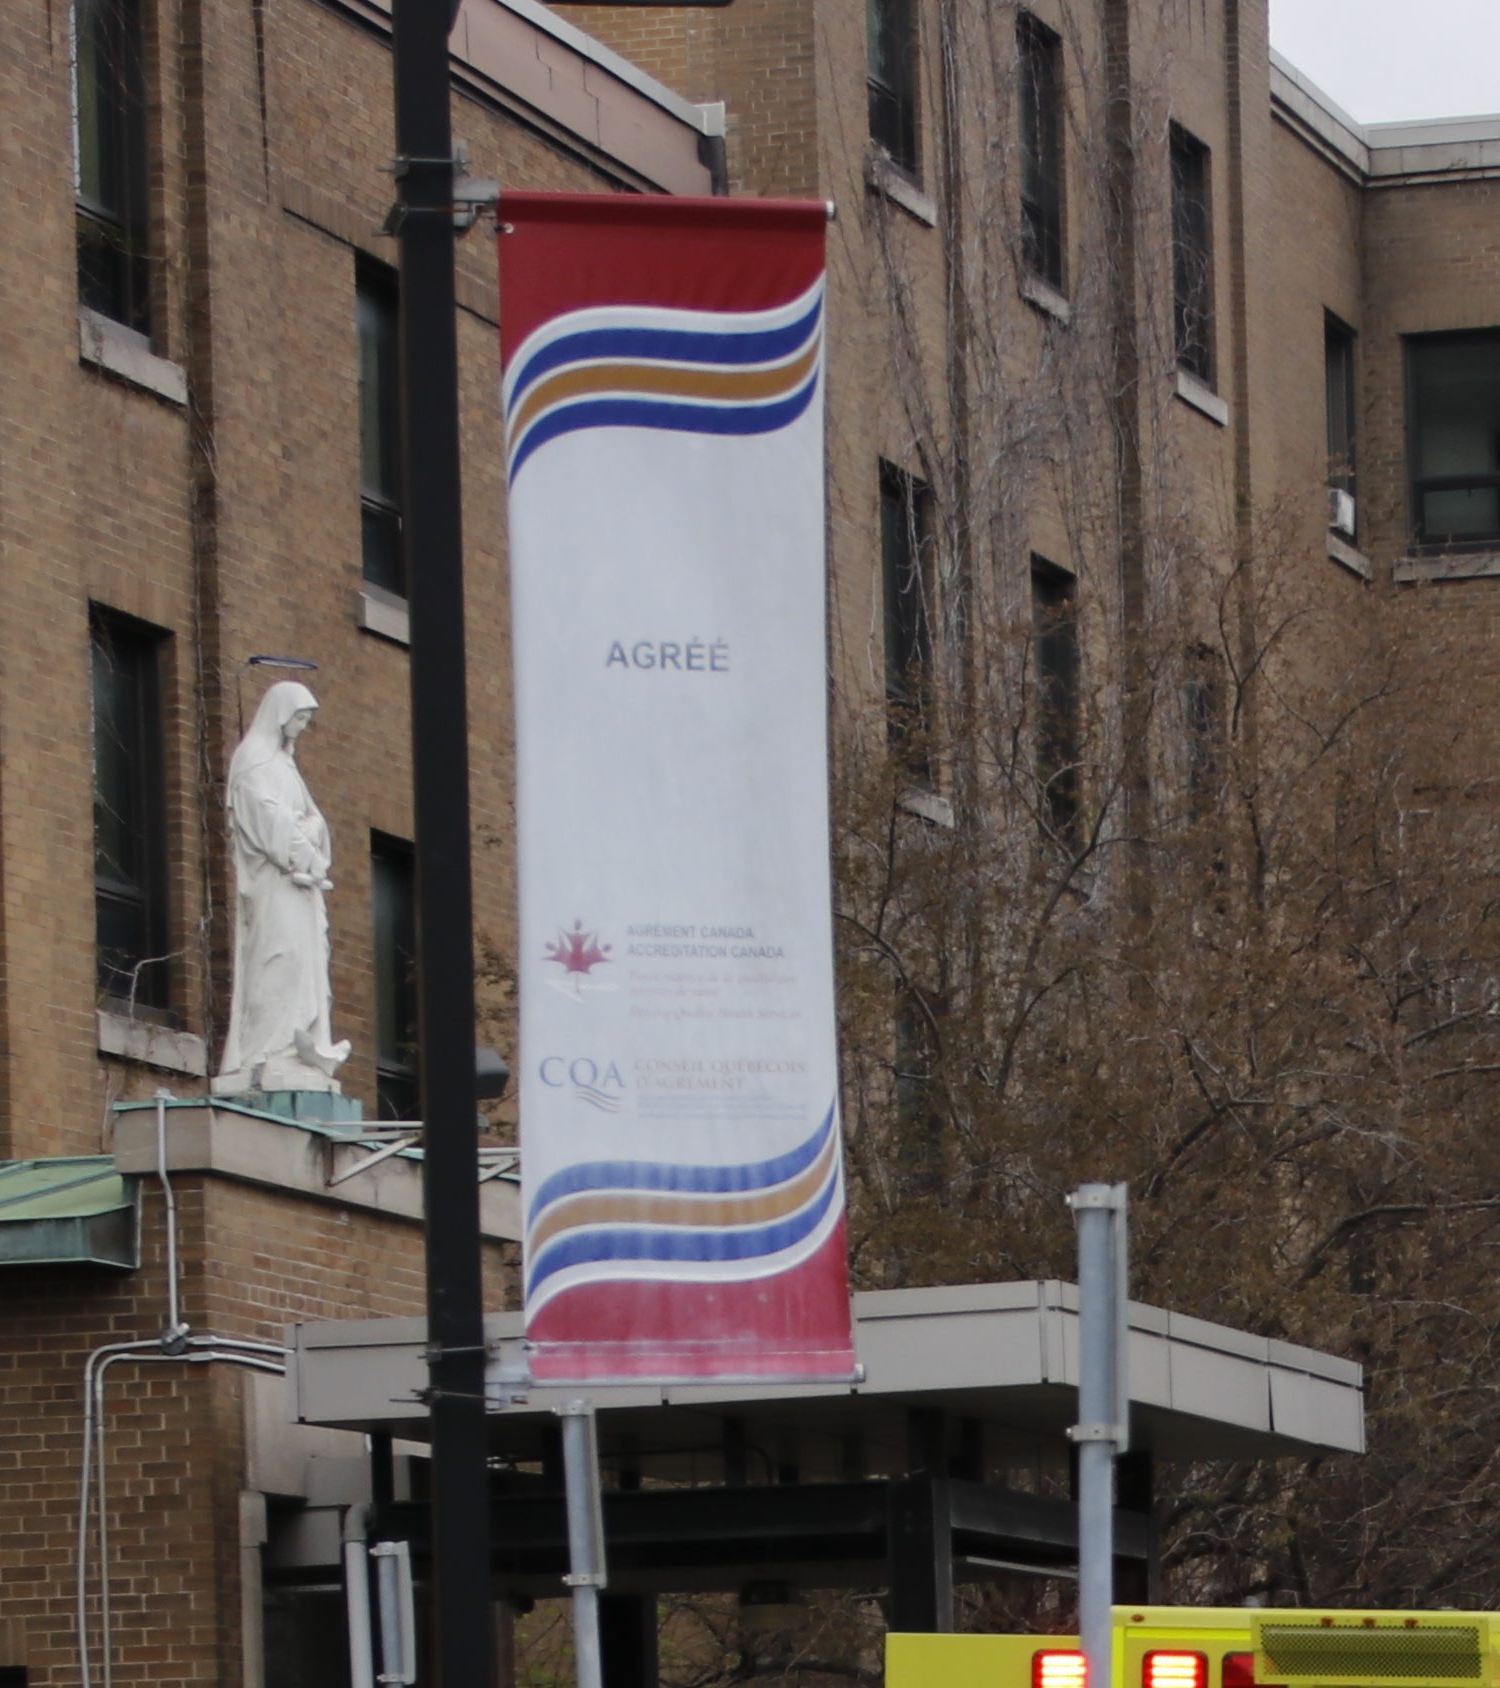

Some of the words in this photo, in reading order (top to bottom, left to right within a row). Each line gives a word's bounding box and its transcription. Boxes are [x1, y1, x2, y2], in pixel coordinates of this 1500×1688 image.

[606, 635, 730, 671] AGRÉÉ
[700, 926, 755, 939] CANADA
[731, 945, 785, 960] CANADA
[539, 1056, 625, 1089] CQA
[634, 1058, 706, 1073] CONSEIL
